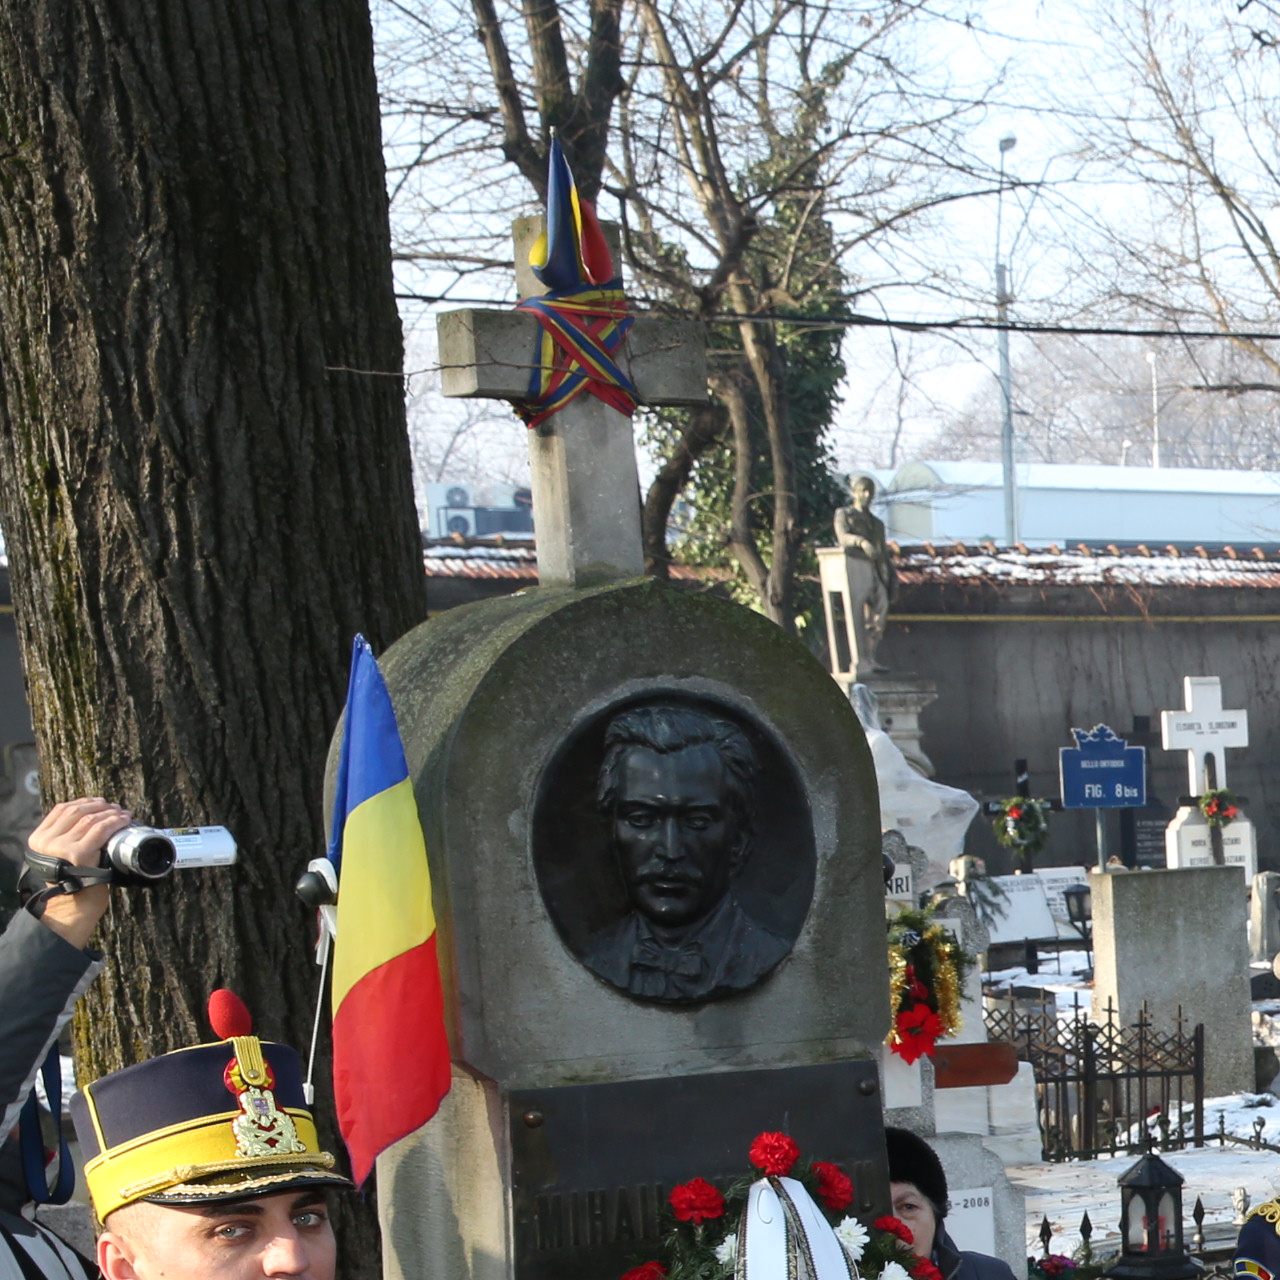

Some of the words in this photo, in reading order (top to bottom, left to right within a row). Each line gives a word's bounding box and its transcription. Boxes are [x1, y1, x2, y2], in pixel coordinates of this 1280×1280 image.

[1085, 784, 1106, 798] FIG.
[1115, 784, 1123, 798] 8
[1124, 785, 1138, 798] bis
[885, 876, 909, 896] NRI
